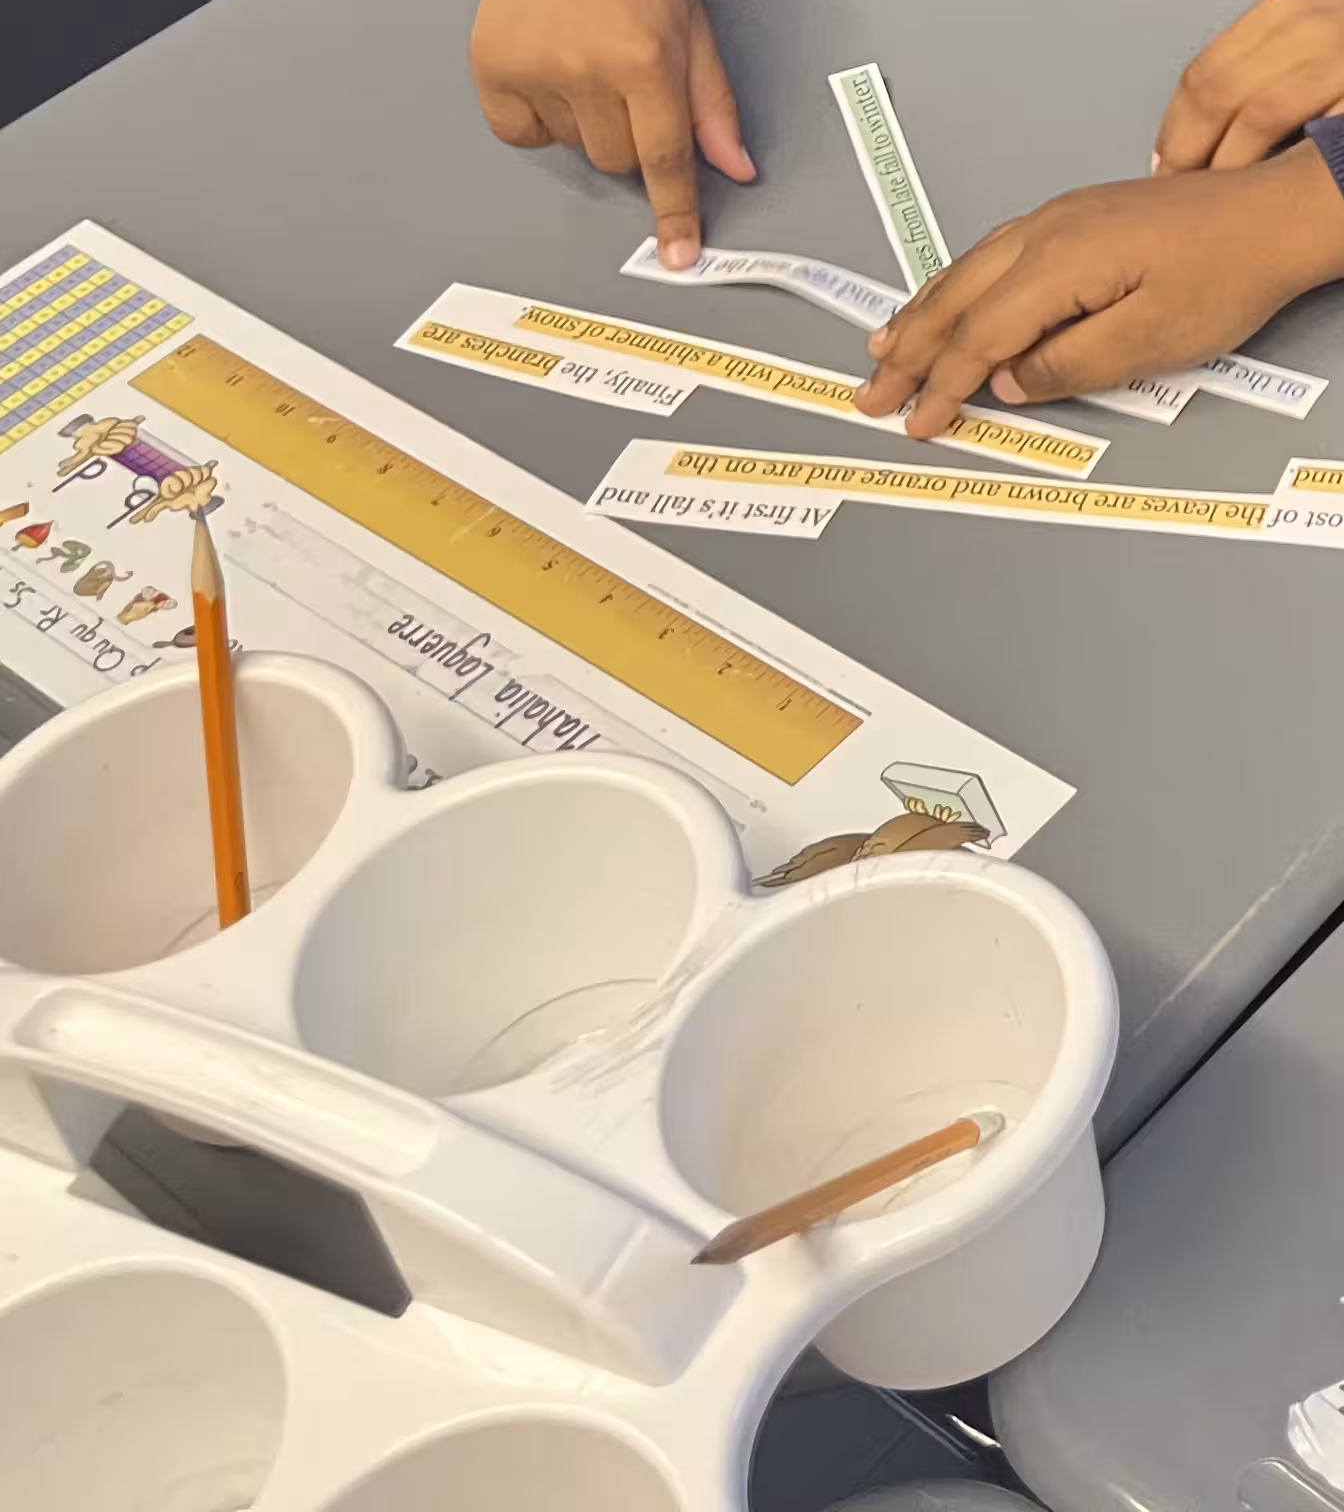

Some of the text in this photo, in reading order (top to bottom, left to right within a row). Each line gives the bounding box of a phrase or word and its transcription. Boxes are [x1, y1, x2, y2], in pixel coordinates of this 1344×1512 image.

[873, 134, 891, 151] to
[873, 151, 901, 176] fall
[889, 178, 913, 208] late
[901, 207, 928, 245] from
[521, 306, 577, 333] snow.
[576, 320, 605, 340] of
[611, 329, 706, 366] shimmer
[422, 325, 685, 407] Finally, the branches are
[724, 356, 773, 381] with
[772, 366, 857, 404] overed
[1128, 378, 1183, 409] Then
[1235, 369, 1312, 399] on the
[967, 419, 1097, 464] completely
[678, 453, 720, 476] the
[724, 459, 756, 475] on
[762, 462, 803, 478] are
[804, 463, 857, 485] and
[860, 469, 947, 492] orange
[949, 477, 1000, 500] and
[597, 486, 832, 527] At first it's fall and
[1007, 484, 1088, 512] brown
[1093, 492, 1135, 510] are
[1141, 498, 1218, 523] leaves
[1224, 505, 1267, 529] the
[1267, 509, 1298, 529] of
[3, 581, 37, 609] Ss
[33, 605, 69, 633] Rr
[387, 613, 494, 702] Laguerre
